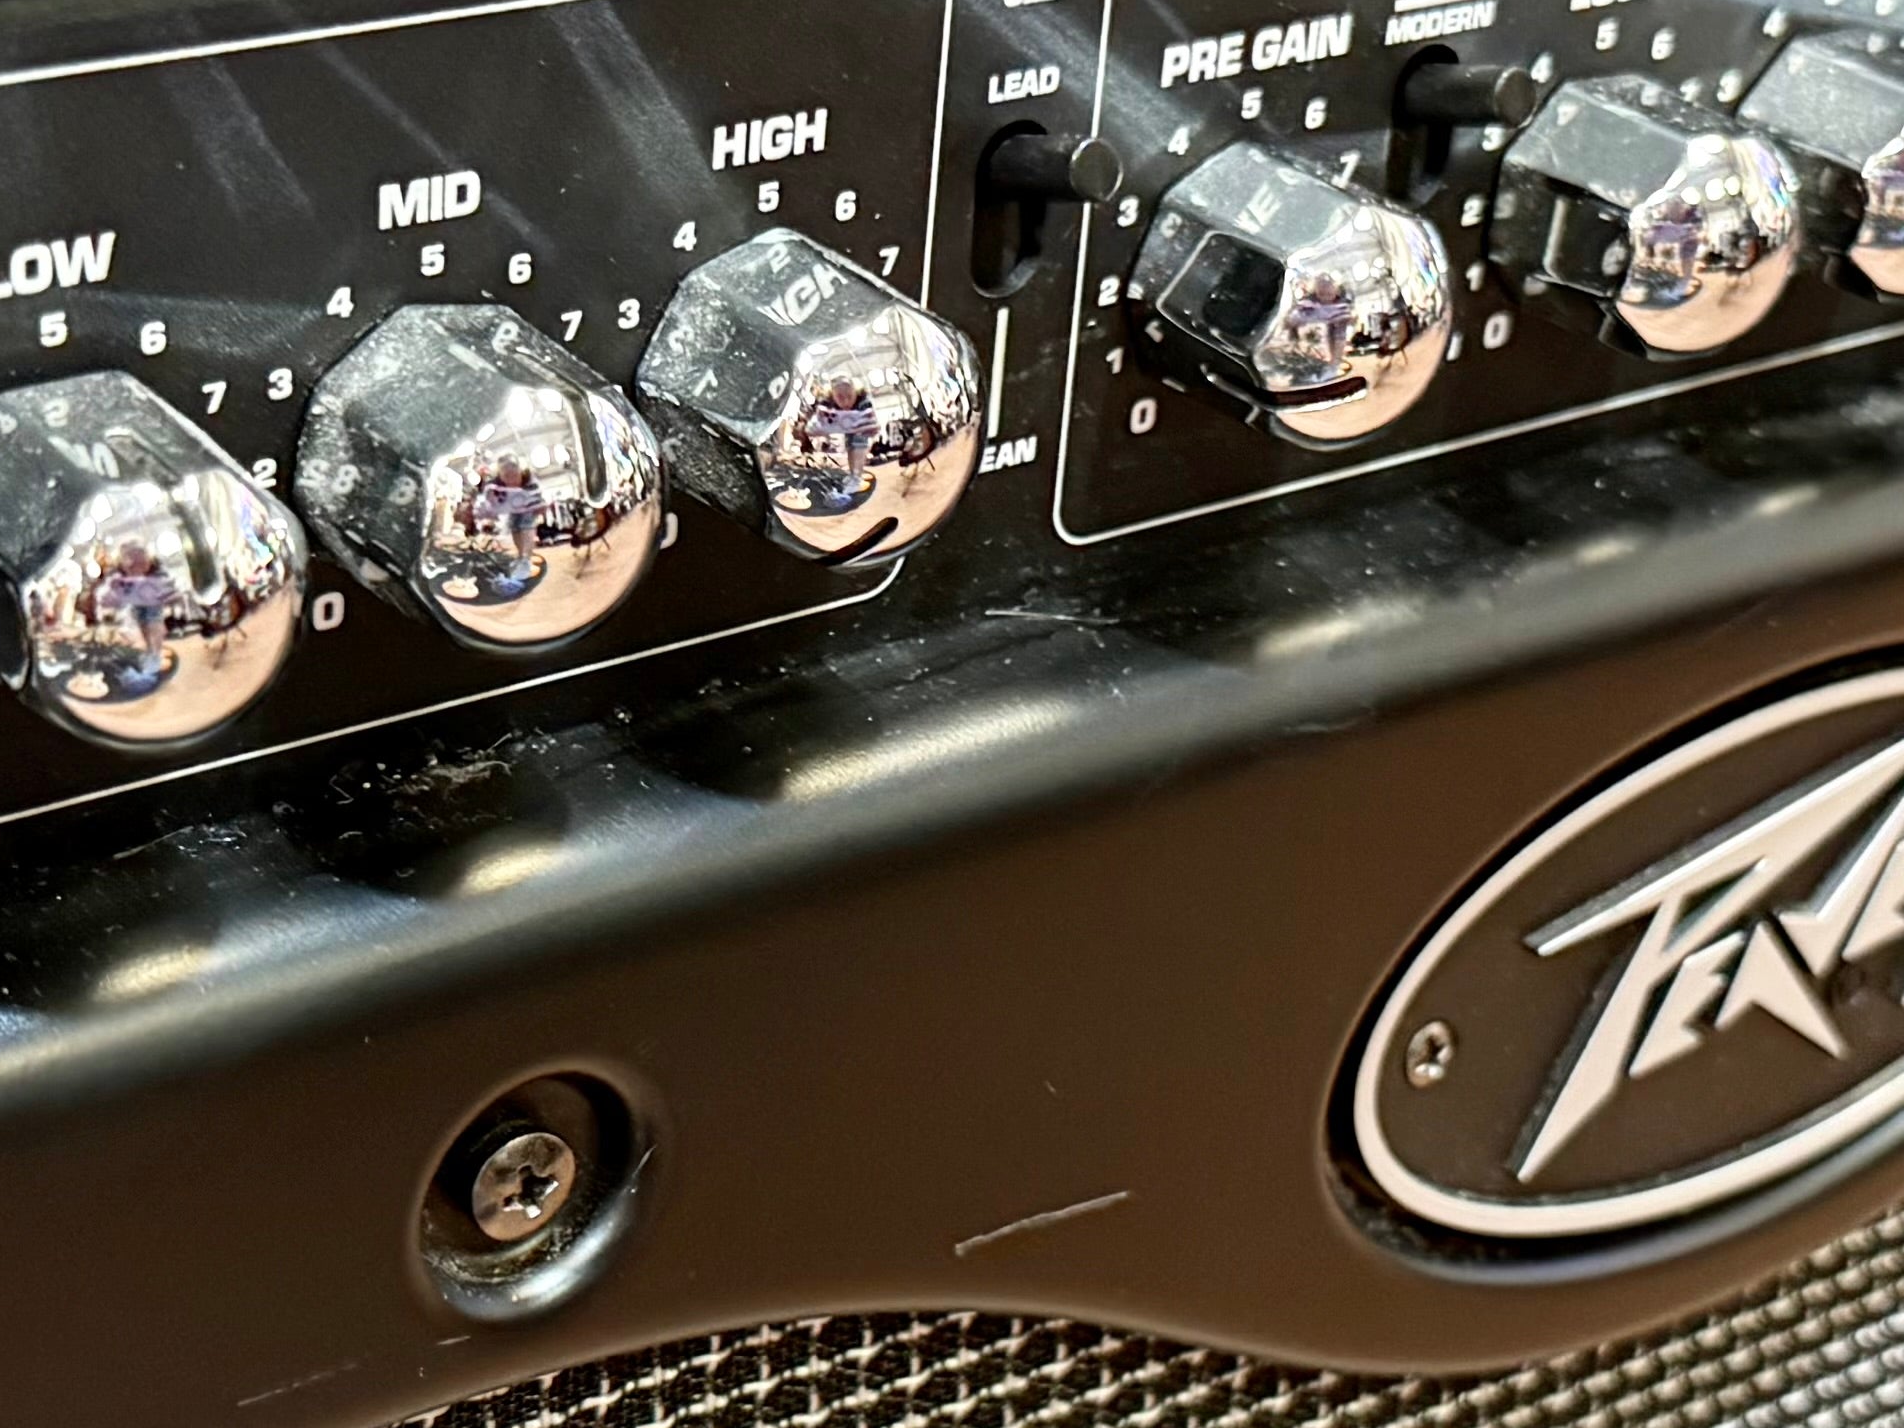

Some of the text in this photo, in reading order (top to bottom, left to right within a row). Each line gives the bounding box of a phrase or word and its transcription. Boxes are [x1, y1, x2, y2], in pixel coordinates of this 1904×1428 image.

[1385, 1, 1496, 45] MODERN
[1596, 19, 1617, 49] 5
[1161, 13, 1353, 88] PRE GAIN
[1652, 29, 1673, 59] 6
[988, 64, 1060, 103] LEAD
[1531, 55, 1551, 83] 4
[1241, 89, 1262, 119] 5
[1305, 99, 1326, 129] 6
[712, 108, 827, 170] HIGH
[1167, 123, 1191, 156] 4
[1482, 125, 1502, 152] 3
[1339, 151, 1361, 188] 7
[379, 170, 480, 230] MID
[758, 181, 779, 212] 5
[836, 191, 856, 221] 6
[1118, 197, 1138, 226] 3
[1461, 197, 1483, 226] 2
[673, 221, 697, 251] 4
[421, 244, 444, 276] 5
[509, 253, 531, 283] 6
[879, 247, 899, 276] 7
[1098, 276, 1120, 306] 2
[1466, 265, 1482, 290] 1
[327, 287, 354, 317] 4
[618, 299, 640, 329] 3
[40, 311, 67, 347] 5
[140, 321, 166, 355] 6
[561, 310, 582, 341] 7
[1484, 314, 1509, 348] 0
[1106, 348, 1122, 373] 1
[202, 381, 226, 414] 7
[268, 368, 292, 400] 3
[1131, 399, 1156, 433] 0
[979, 436, 1037, 473] EAN
[253, 458, 276, 486] 2
[313, 592, 344, 630] 0
